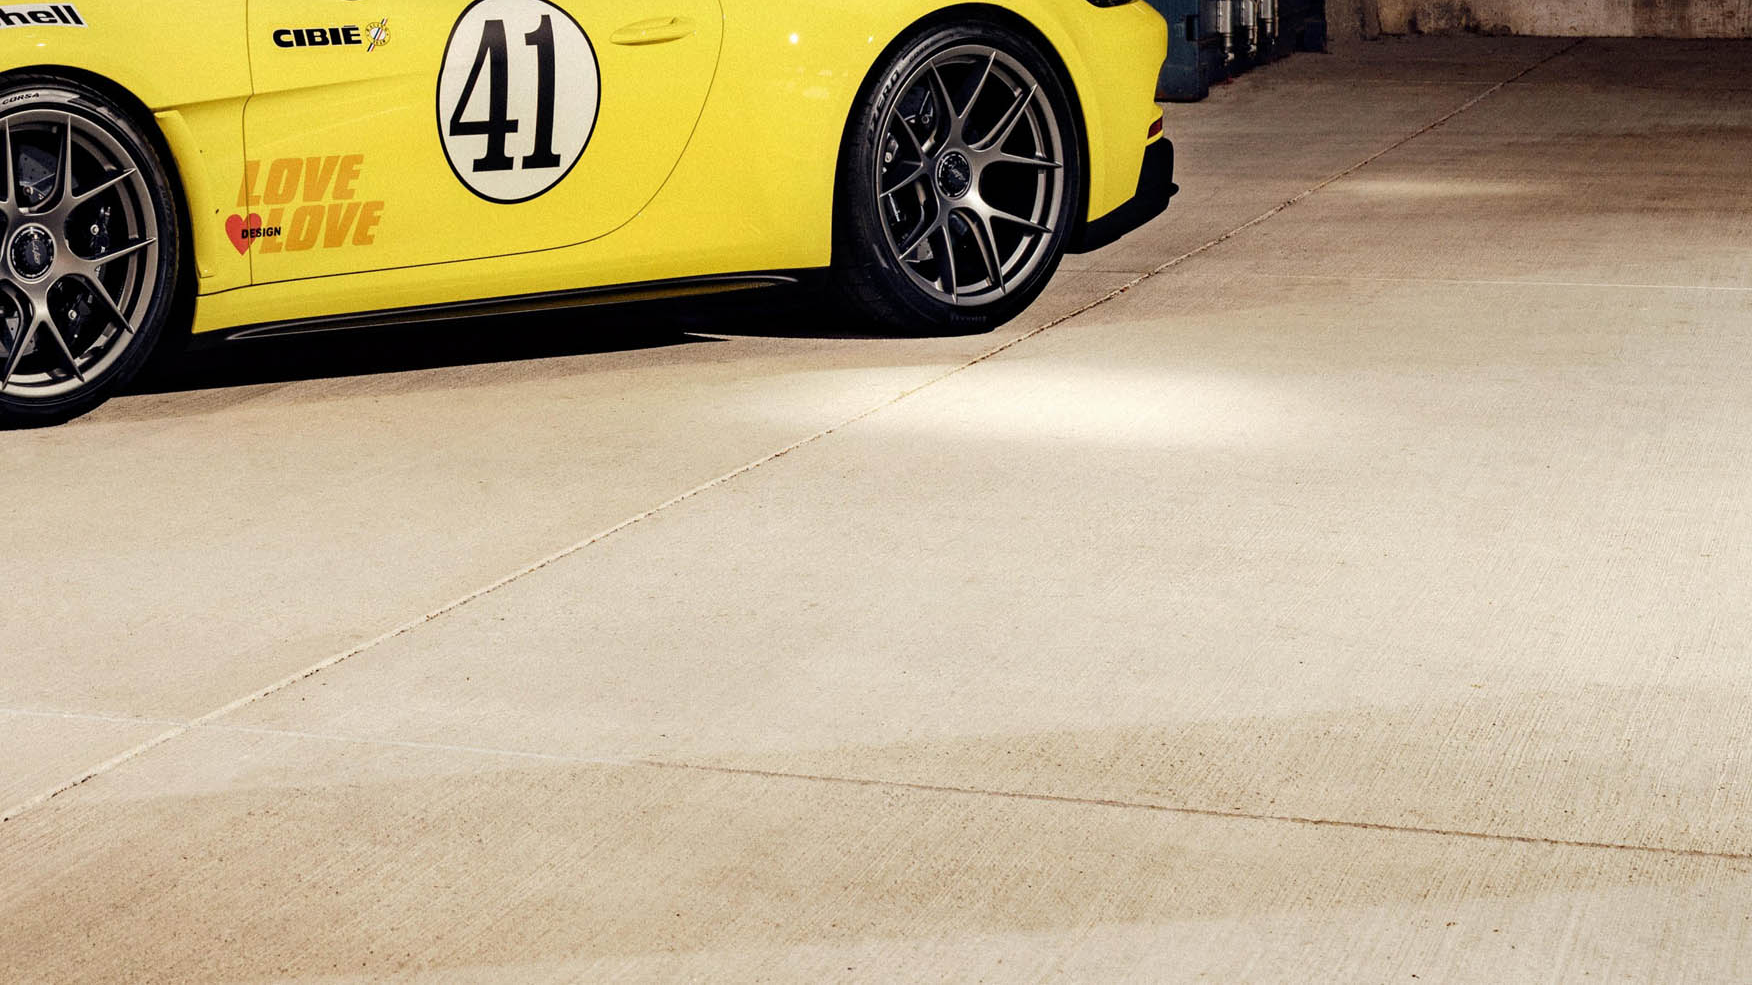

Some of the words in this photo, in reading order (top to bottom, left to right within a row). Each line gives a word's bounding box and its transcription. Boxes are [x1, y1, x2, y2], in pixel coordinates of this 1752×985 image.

[2, 92, 40, 105] CORSA
[449, 14, 561, 172] 41
[236, 154, 365, 208] LOVE
[241, 226, 282, 239] DESIGN
[259, 200, 385, 255] LOVE
